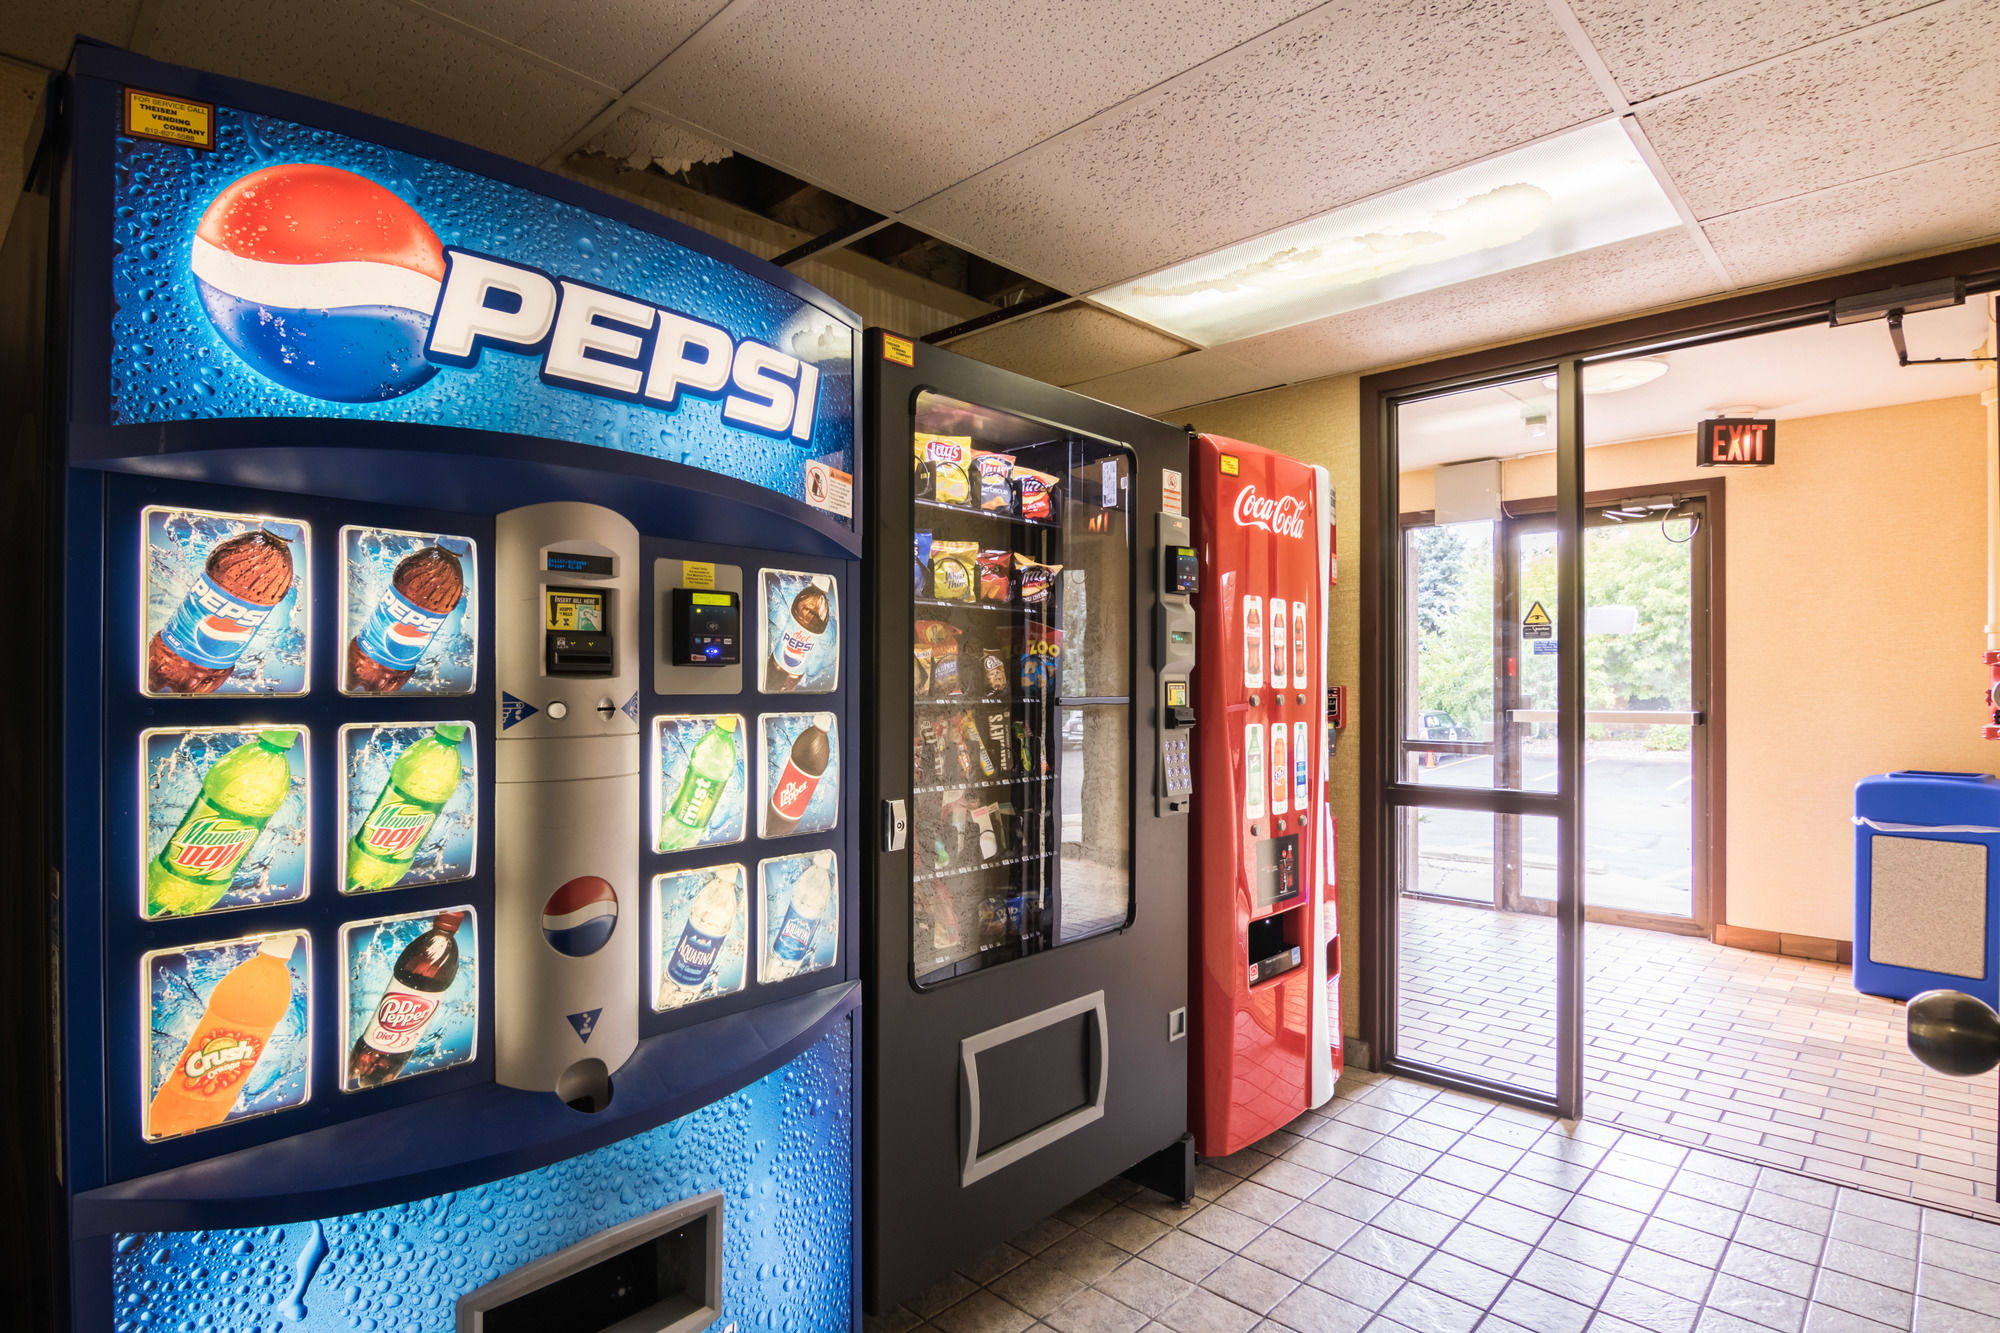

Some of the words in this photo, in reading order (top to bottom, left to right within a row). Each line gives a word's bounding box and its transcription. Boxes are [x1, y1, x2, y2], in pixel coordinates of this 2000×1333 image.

[133, 95, 150, 104] FOR
[152, 98, 185, 111] SERVICE
[187, 105, 206, 115] CALL
[140, 103, 177, 116] THEISEN
[152, 113, 191, 126] VENDING
[163, 123, 206, 137] COMPANY
[429, 250, 819, 441] PEPSI
[1712, 424, 1768, 461] EXIT
[1233, 485, 1306, 539] Coca-Cola
[191, 578, 270, 627] PEPSI
[382, 588, 445, 633] PEPSI
[783, 632, 814, 651] PEPSI
[787, 781, 797, 796] Dr
[182, 822, 256, 846] Mountain
[678, 935, 716, 967] AQUAFINA
[379, 1001, 431, 1026] Pepper
[398, 1000, 421, 1015] Dr
[375, 1031, 396, 1041] Diet
[185, 1041, 253, 1078] Crush
